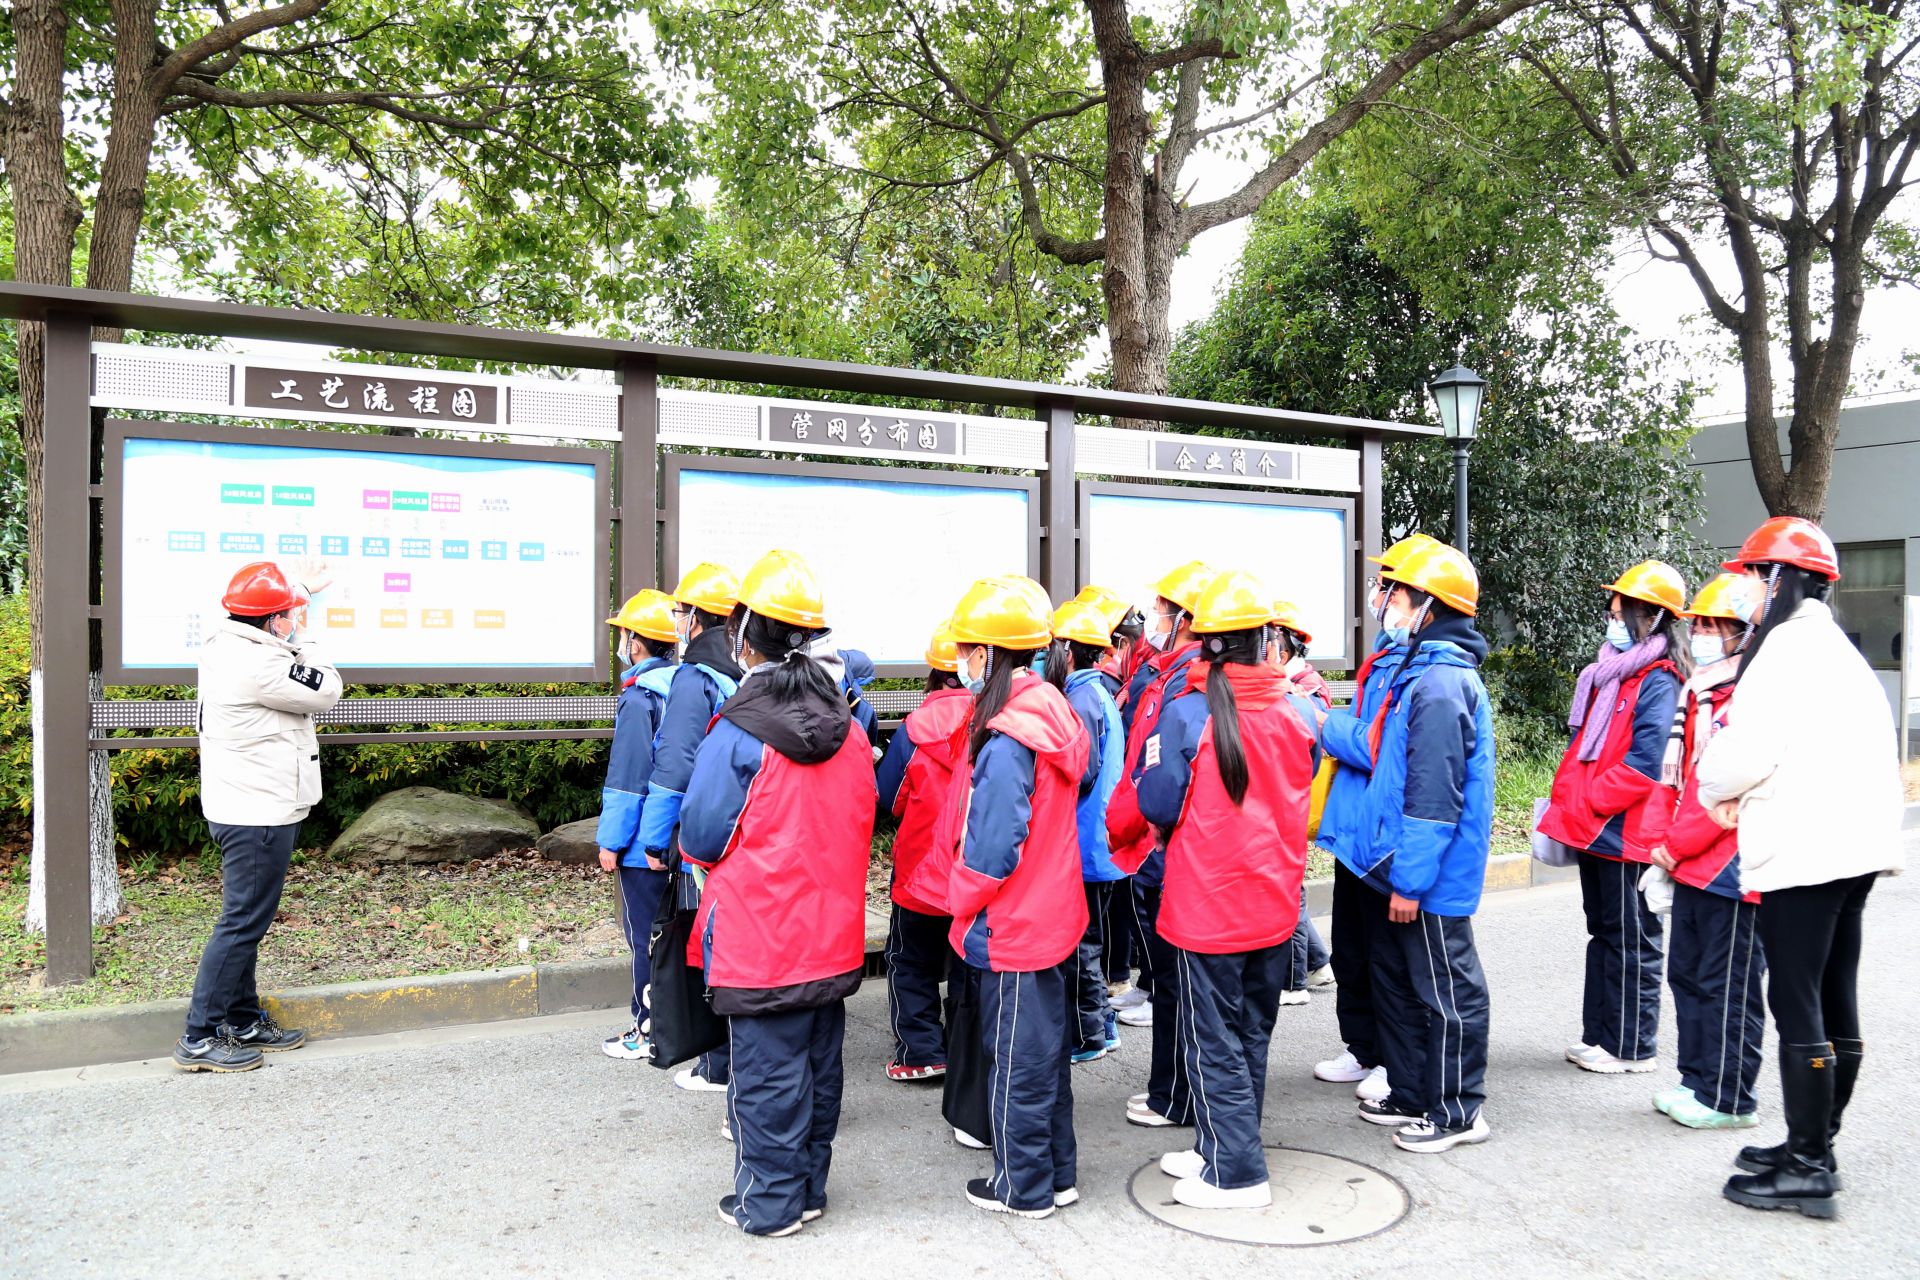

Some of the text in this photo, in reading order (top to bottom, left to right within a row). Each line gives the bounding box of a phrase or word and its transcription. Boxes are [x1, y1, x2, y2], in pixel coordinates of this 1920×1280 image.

[271, 377, 477, 419] 工艺流程图
[791, 411, 938, 450] 管网分布图
[1174, 446, 1277, 477] 企业简介
